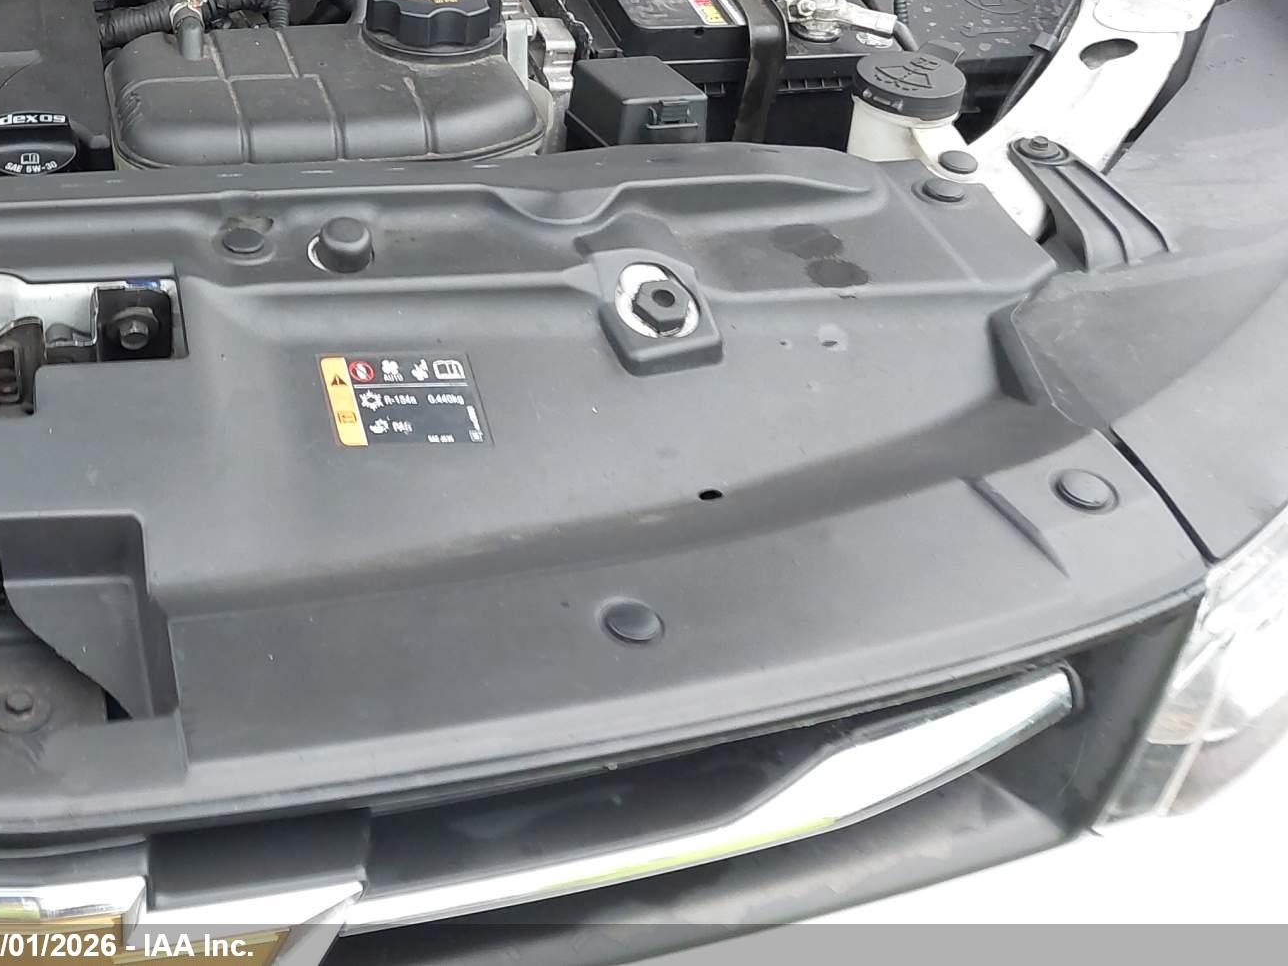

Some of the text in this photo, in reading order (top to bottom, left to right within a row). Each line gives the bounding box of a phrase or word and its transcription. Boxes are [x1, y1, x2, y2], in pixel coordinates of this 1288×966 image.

[4, 160, 58, 173] SAE 5W-30
[383, 373, 404, 382] AUTO
